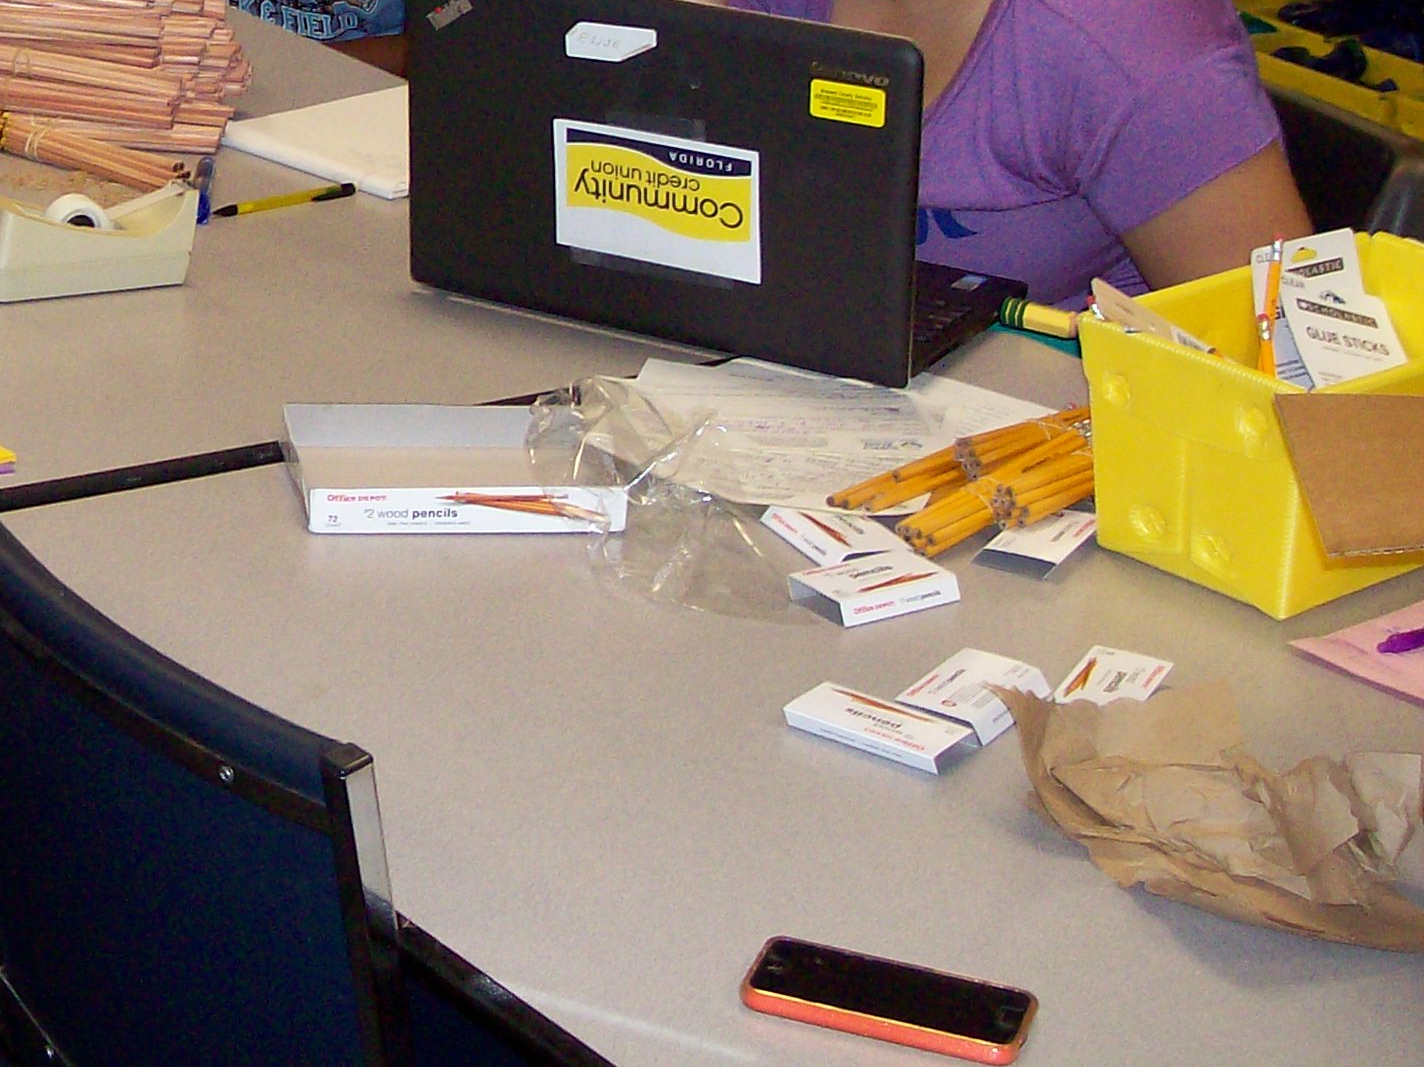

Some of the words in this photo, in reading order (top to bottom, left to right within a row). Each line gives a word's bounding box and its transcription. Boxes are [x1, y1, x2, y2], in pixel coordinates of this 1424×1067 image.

[590, 159, 642, 181] union
[668, 150, 733, 173] FLORIDA
[645, 170, 701, 192] credit
[574, 168, 744, 229] Community
[1306, 326, 1341, 345] GLUE
[1342, 335, 1390, 356] STICKS
[327, 494, 356, 502] Office
[377, 508, 409, 518] wood
[412, 507, 458, 520] pencils
